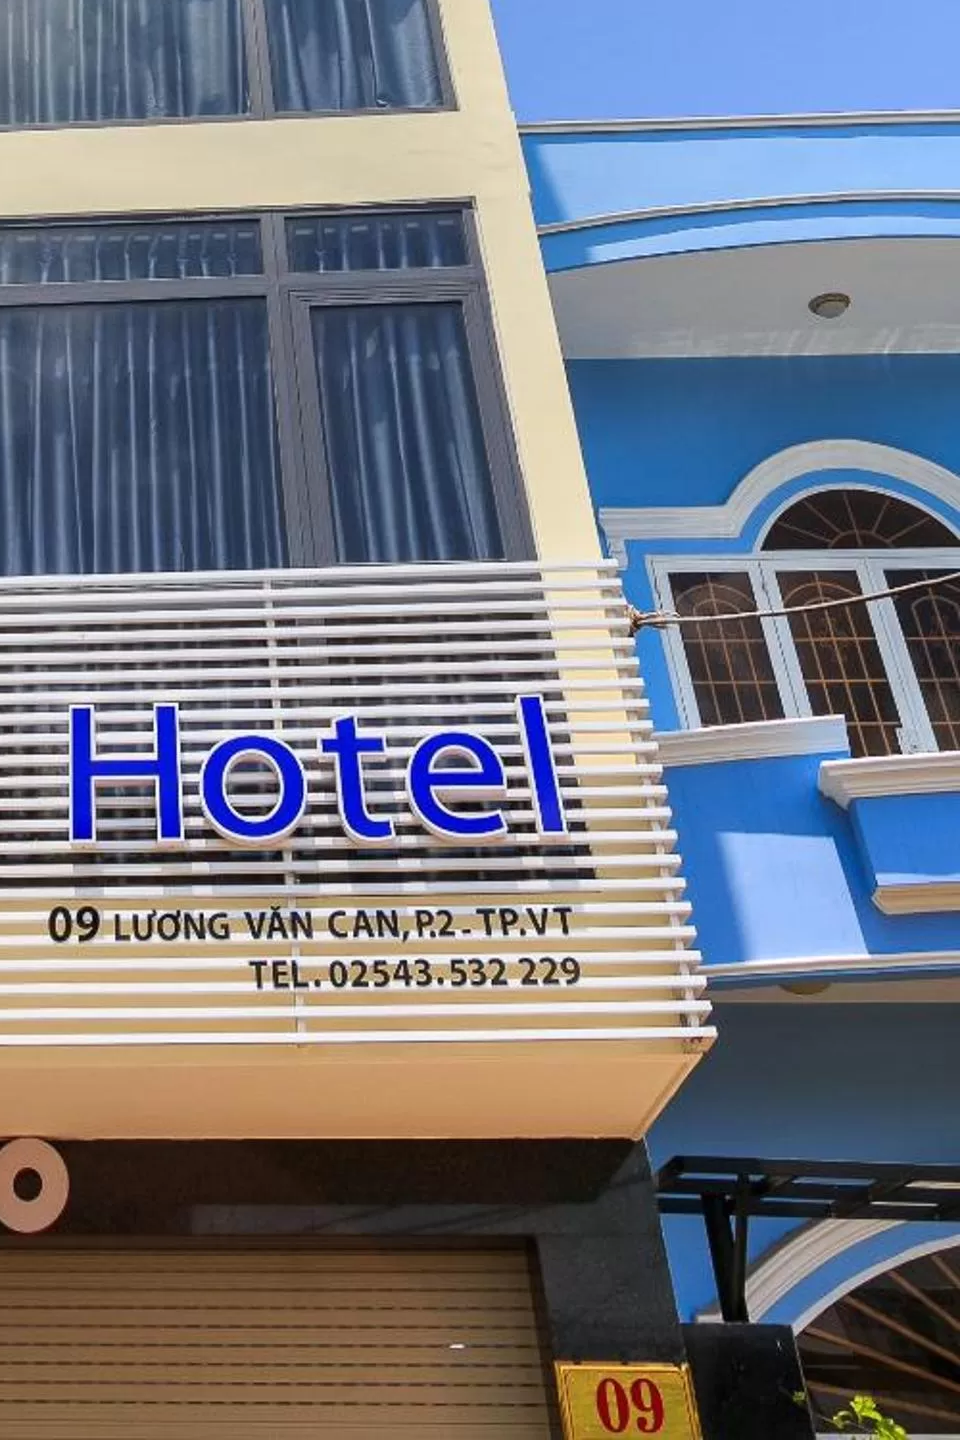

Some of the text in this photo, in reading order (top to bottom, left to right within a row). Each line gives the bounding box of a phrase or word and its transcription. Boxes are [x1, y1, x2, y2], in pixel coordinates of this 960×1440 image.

[69, 694, 570, 844] Hotel
[48, 905, 101, 943] 09
[114, 909, 230, 942] LƯƠNG
[244, 905, 315, 941] VĂN
[518, 956, 581, 986] 229
[595, 1377, 665, 1433] 09
